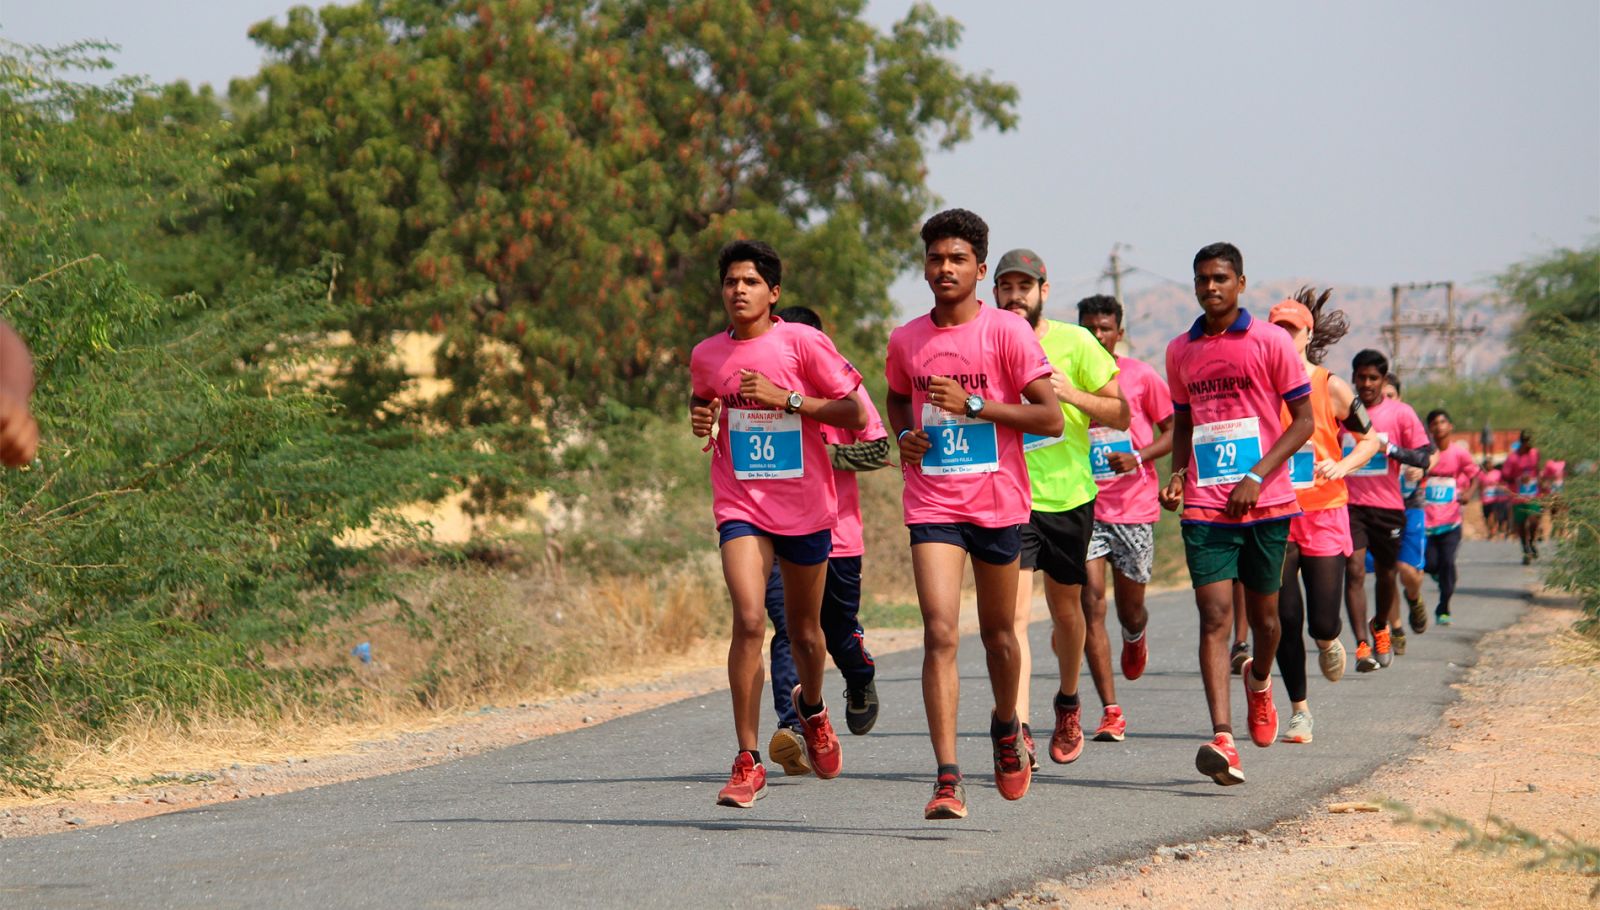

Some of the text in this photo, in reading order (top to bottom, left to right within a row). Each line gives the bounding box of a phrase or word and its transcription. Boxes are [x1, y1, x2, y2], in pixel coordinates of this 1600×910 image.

[912, 373, 989, 392] ANAAPUR
[747, 412, 784, 420] ANANTAPUR
[749, 434, 775, 461] 36
[942, 427, 970, 456] 34
[1214, 442, 1237, 468] 29
